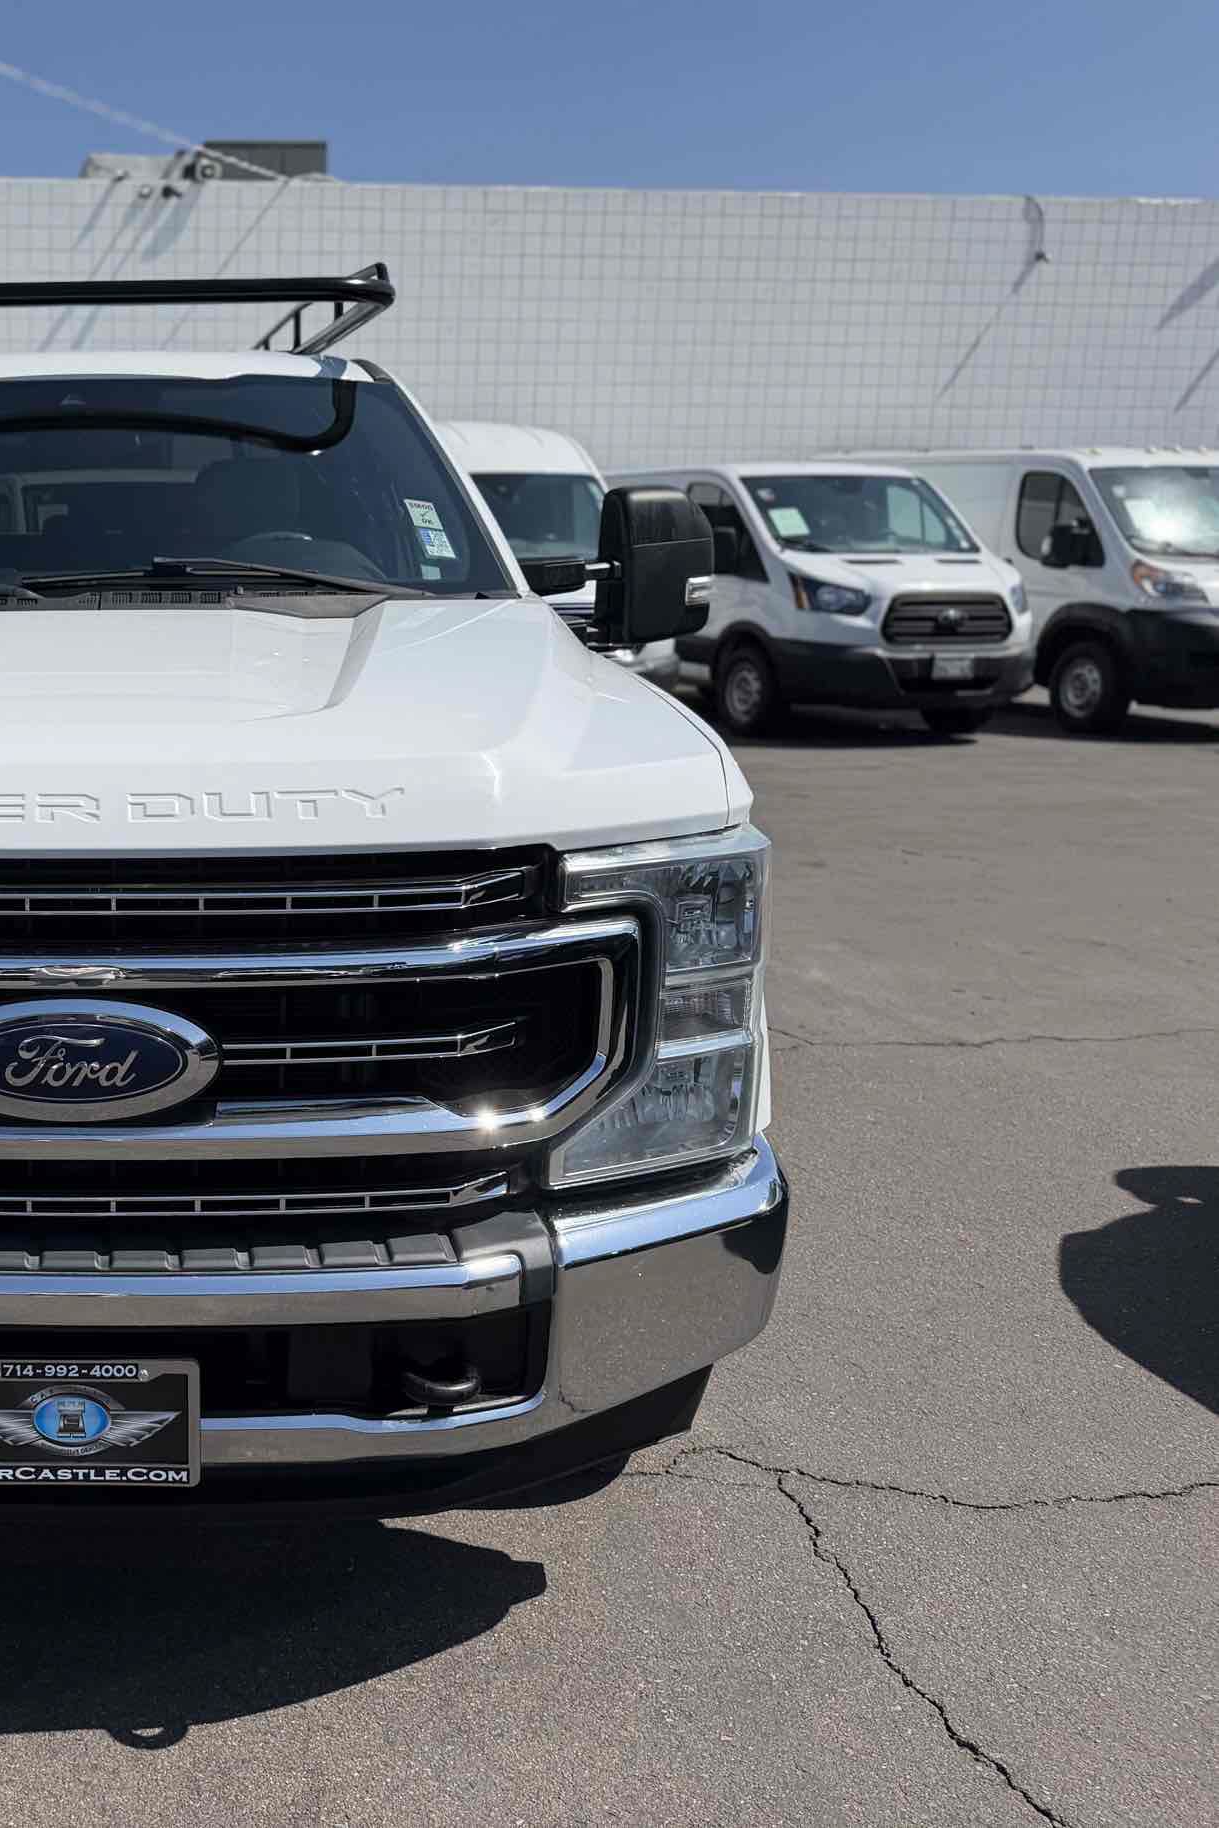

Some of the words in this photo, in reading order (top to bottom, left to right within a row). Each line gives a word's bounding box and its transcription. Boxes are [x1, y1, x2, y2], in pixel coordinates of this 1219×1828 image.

[126, 787, 404, 823] DUTY
[4, 1034, 138, 1088] Ford
[2, 1364, 138, 1378] 714-992-4000
